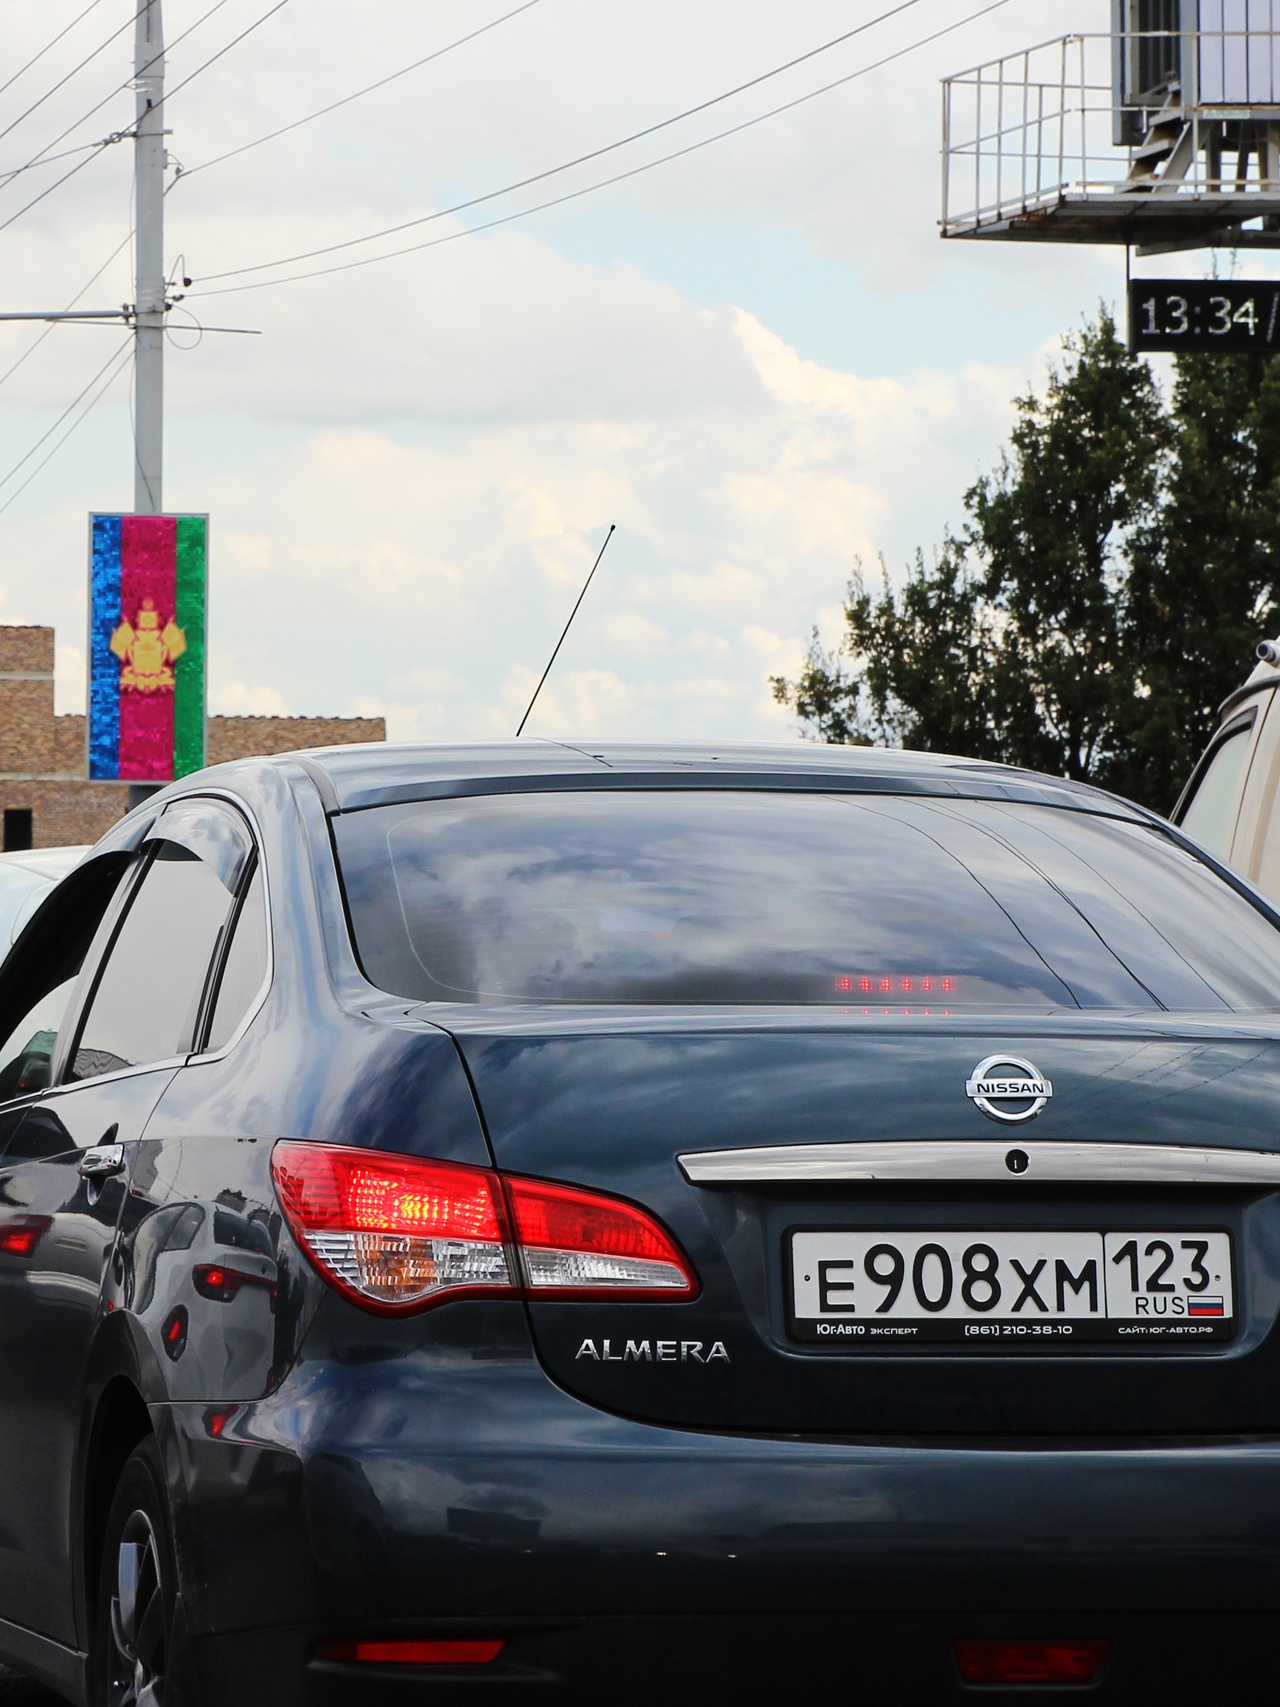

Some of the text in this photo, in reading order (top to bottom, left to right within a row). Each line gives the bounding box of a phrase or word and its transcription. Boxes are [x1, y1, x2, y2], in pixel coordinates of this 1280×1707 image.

[1142, 295, 1259, 336] 13:34
[976, 1083, 1044, 1093] NISSAN
[1111, 1239, 1210, 1293] 123
[1135, 1296, 1185, 1315] RUS
[870, 1327, 918, 1335] ЭКСПЕРТ
[1002, 1325, 1073, 1335] 210-38-10
[1118, 1326, 1214, 1334] САЙТ: ЮГ-АВТО.РФ
[575, 1338, 731, 1363] ALMERA
